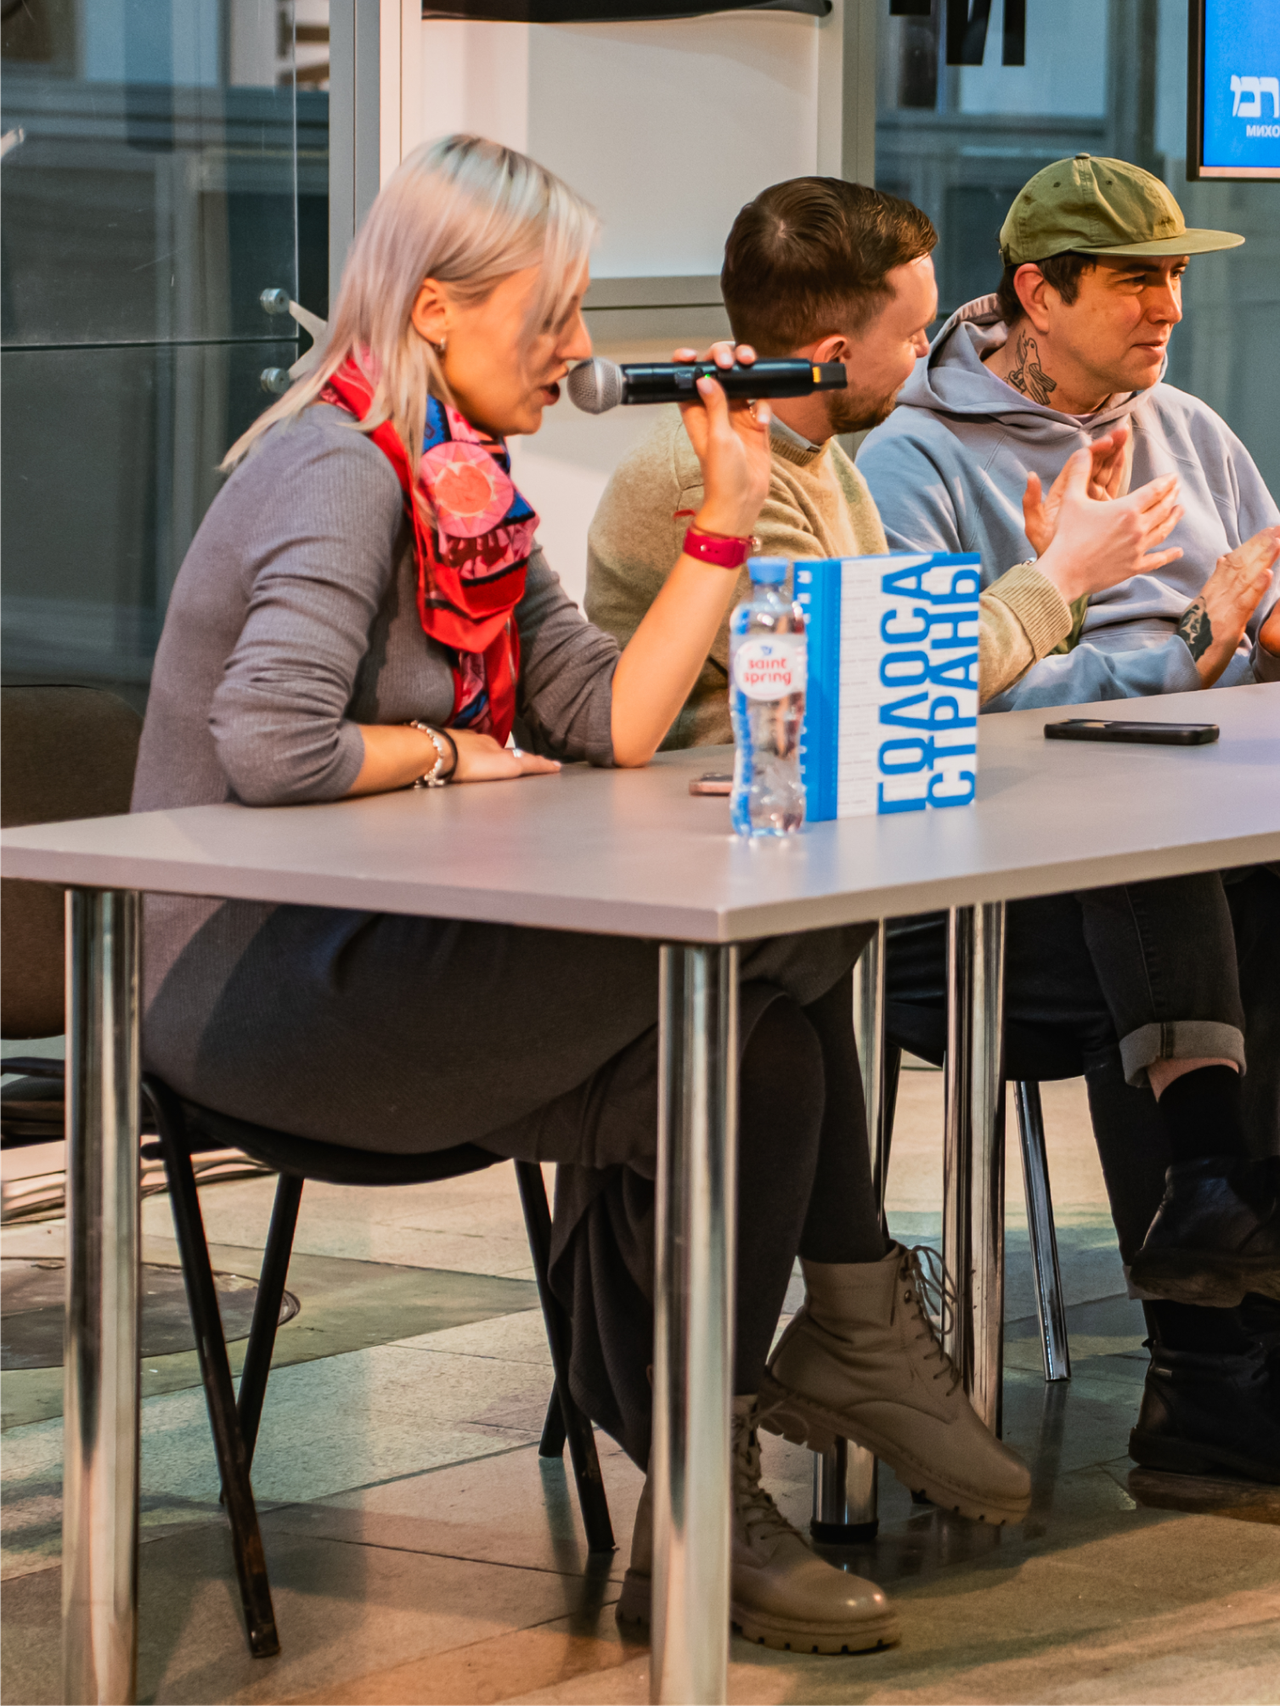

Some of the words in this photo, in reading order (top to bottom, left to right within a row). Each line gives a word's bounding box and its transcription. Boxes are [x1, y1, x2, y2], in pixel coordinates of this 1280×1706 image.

[743, 671, 792, 687] spring
[748, 658, 787, 670] saint
[877, 554, 933, 815] ГОЛОСА
[926, 552, 980, 809] СТРАНЫ
